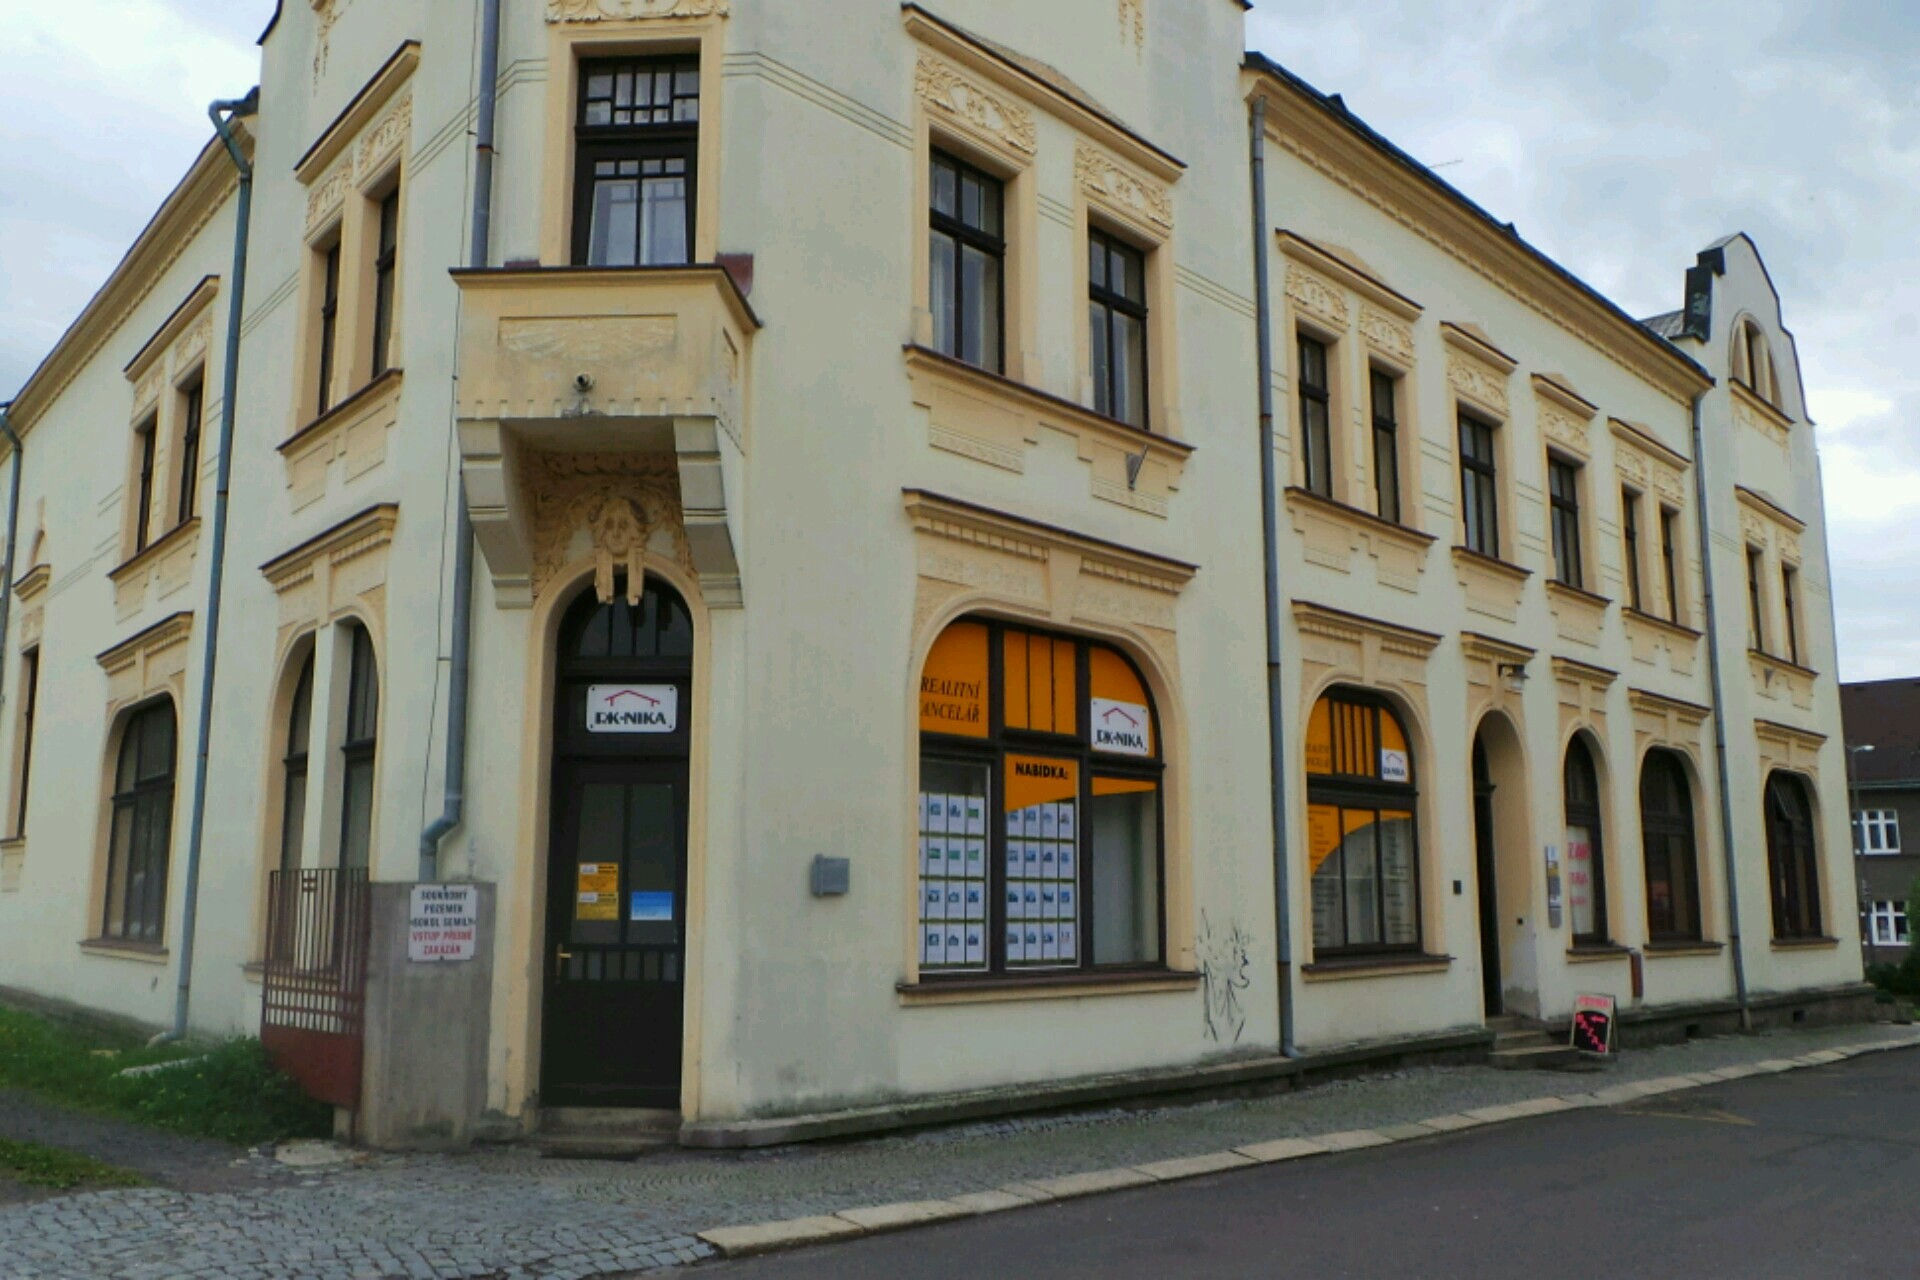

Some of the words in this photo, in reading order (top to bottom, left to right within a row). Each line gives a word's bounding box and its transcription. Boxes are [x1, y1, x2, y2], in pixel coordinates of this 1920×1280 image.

[921, 676, 980, 699] REALITNÍ
[921, 701, 979, 723] ANCELÁŘ
[424, 903, 463, 914] POZEMEK
[412, 931, 440, 941] VSTUP
